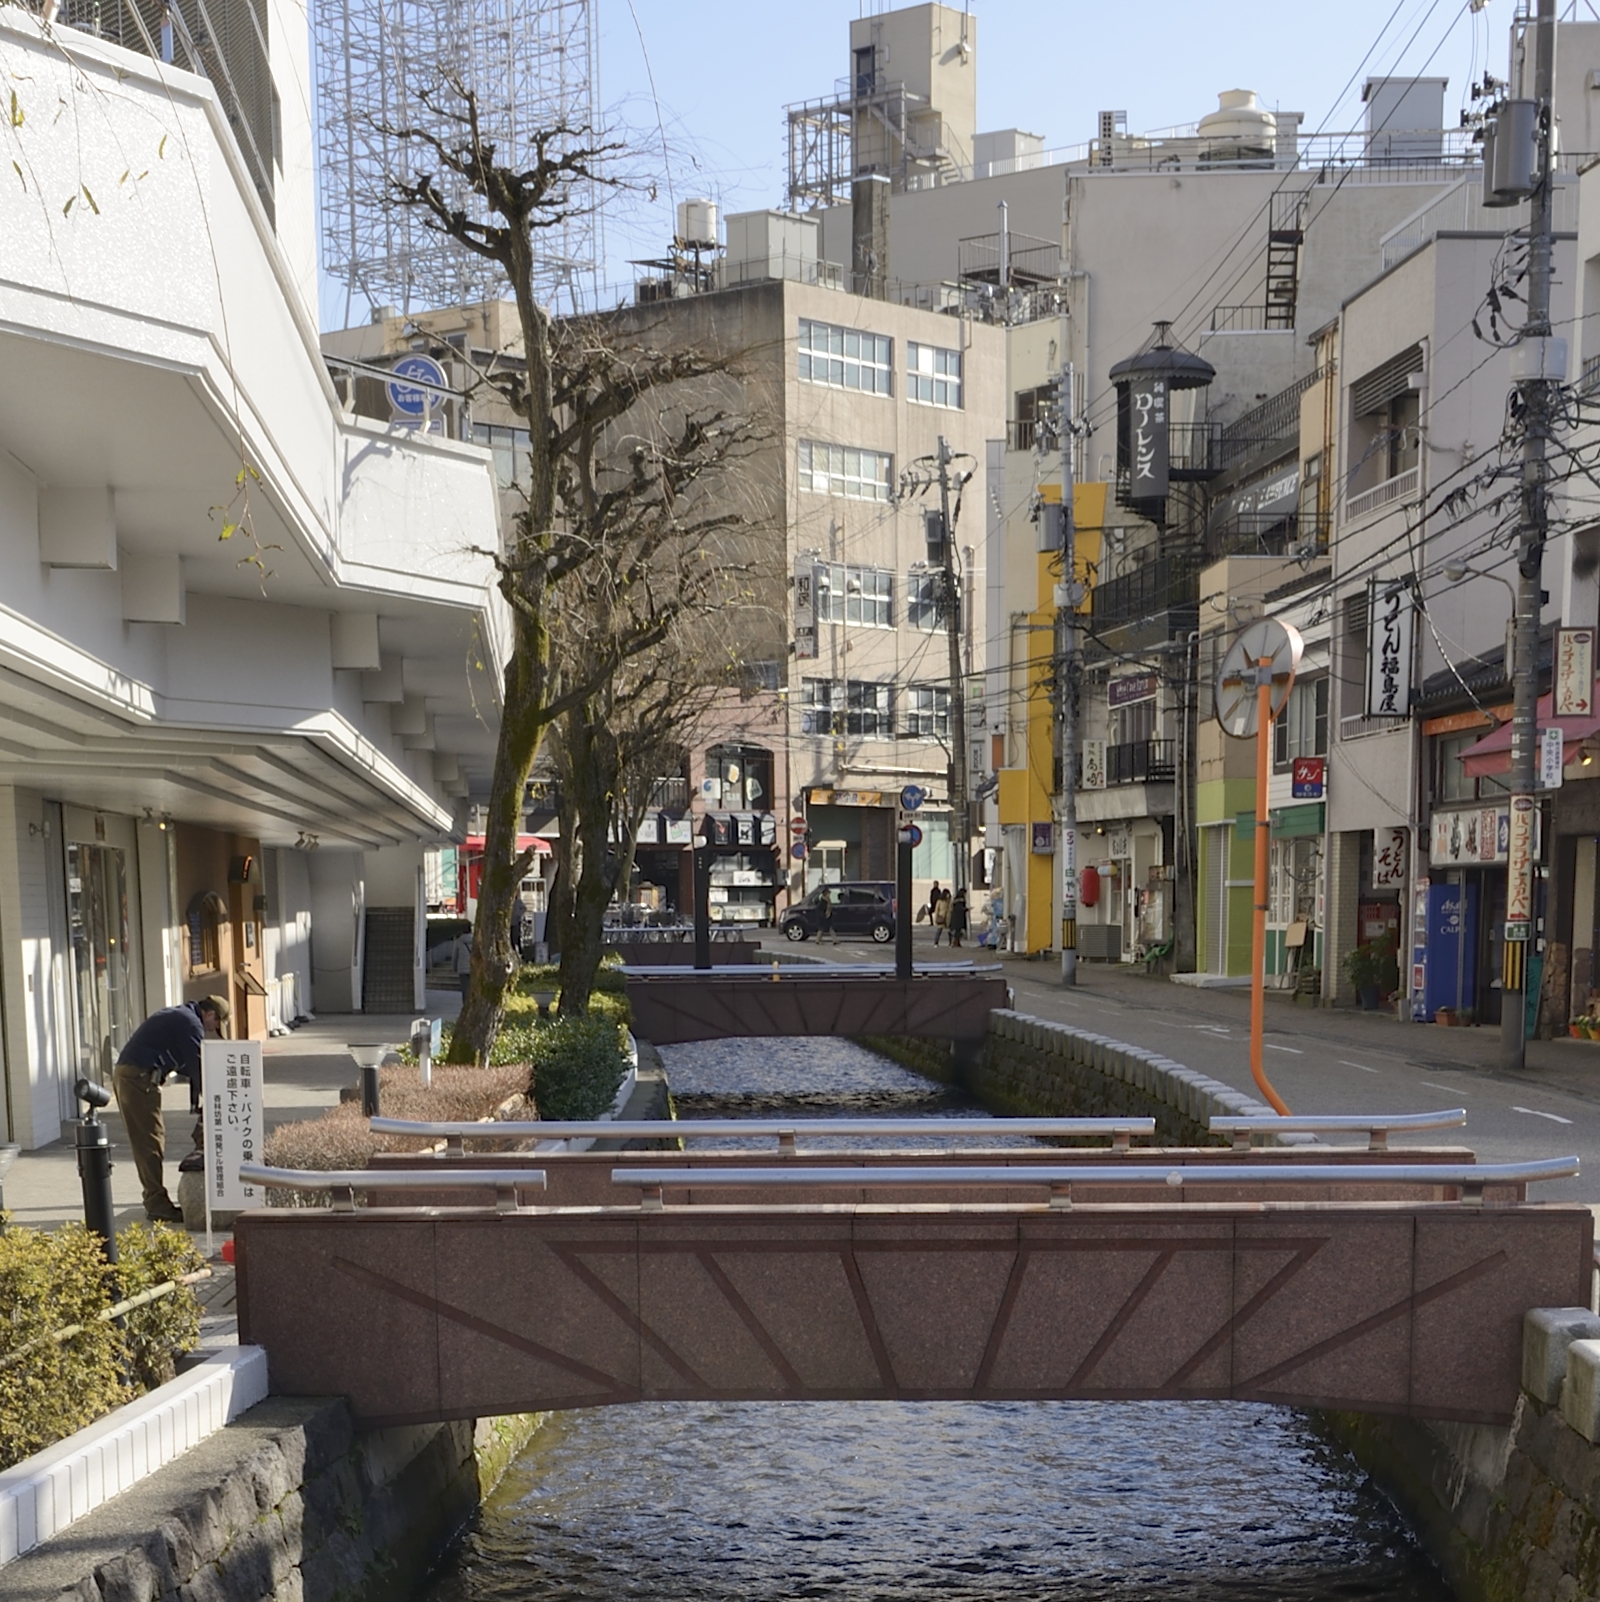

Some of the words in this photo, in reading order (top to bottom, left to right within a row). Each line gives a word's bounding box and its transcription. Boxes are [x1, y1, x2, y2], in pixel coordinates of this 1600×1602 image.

[1296, 765, 1320, 781] サン
[1378, 846, 1391, 885] そば
[1390, 830, 1404, 878] うどん
[240, 1053, 254, 1198] 自転車・バイクの乗は
